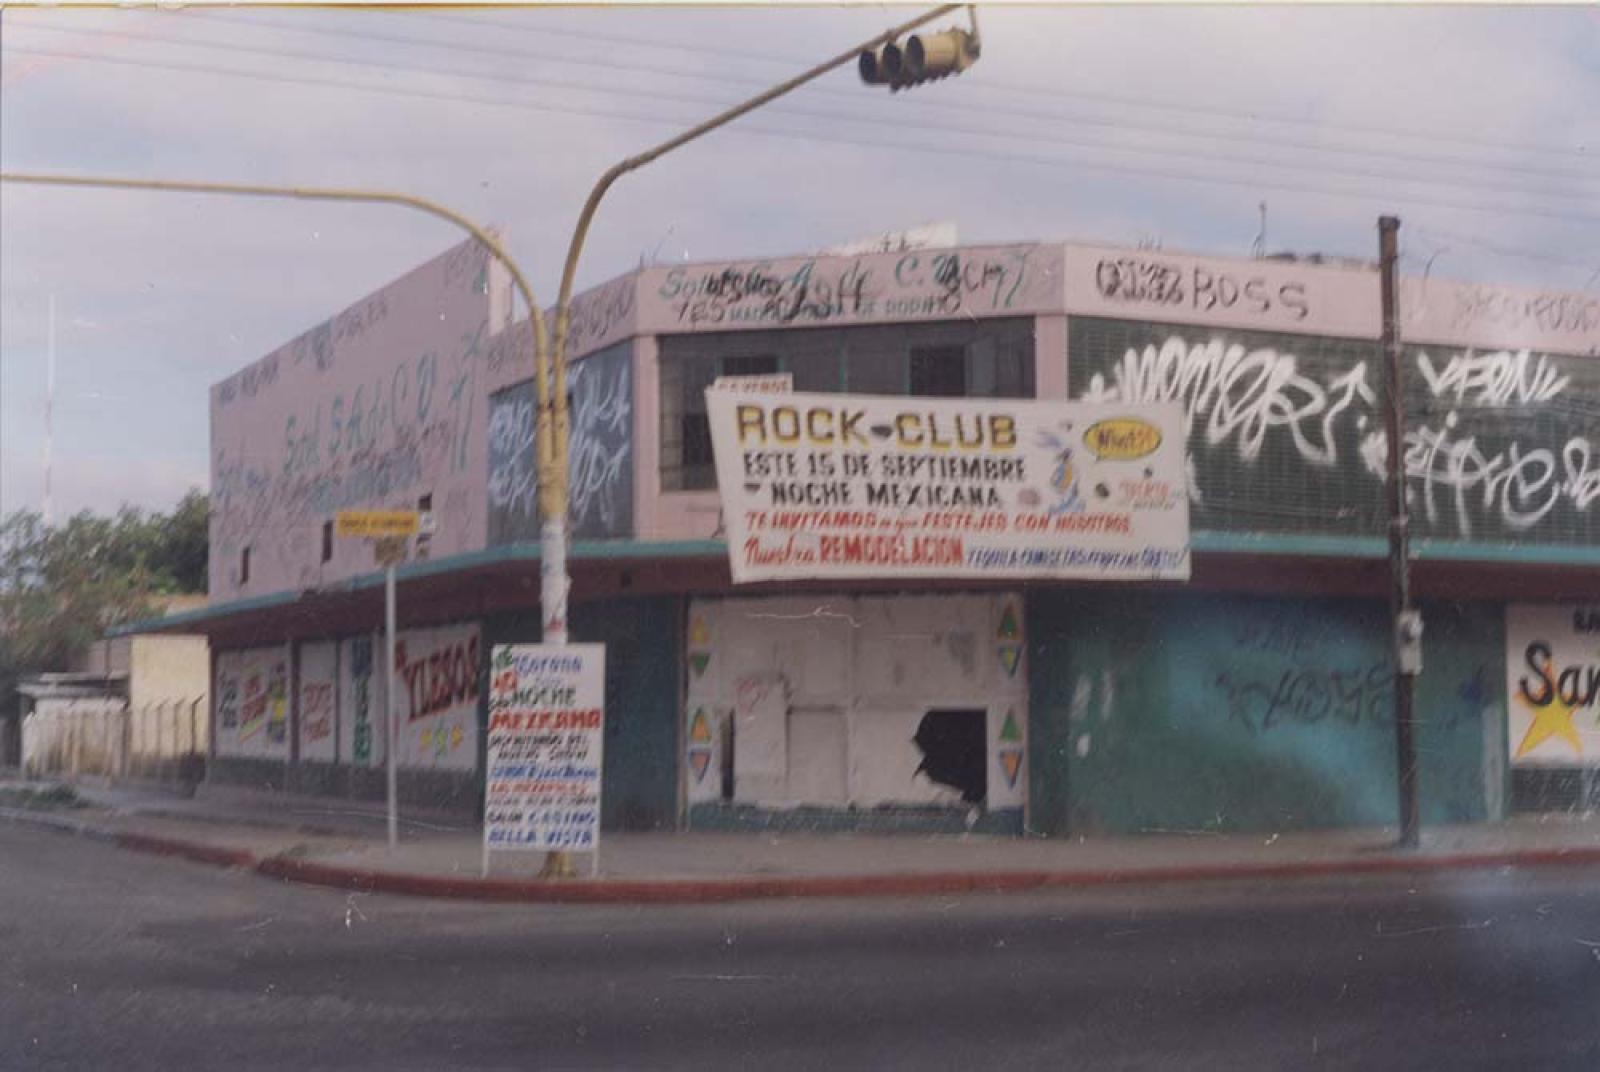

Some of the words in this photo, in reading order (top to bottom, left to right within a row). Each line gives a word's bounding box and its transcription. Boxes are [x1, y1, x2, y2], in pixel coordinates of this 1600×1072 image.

[743, 453, 796, 475] ESTE
[807, 454, 835, 476] 15
[842, 455, 869, 476] DE
[880, 455, 1026, 481] SEPTIEMBRE
[770, 483, 851, 506] NOCHE
[865, 484, 1001, 508] MEXICANA
[746, 512, 766, 529] TE
[771, 512, 876, 529] INVITAMOS
[922, 512, 1007, 531] FESTEJES
[1014, 513, 1050, 531] CON
[819, 534, 963, 566] REMODELACION
